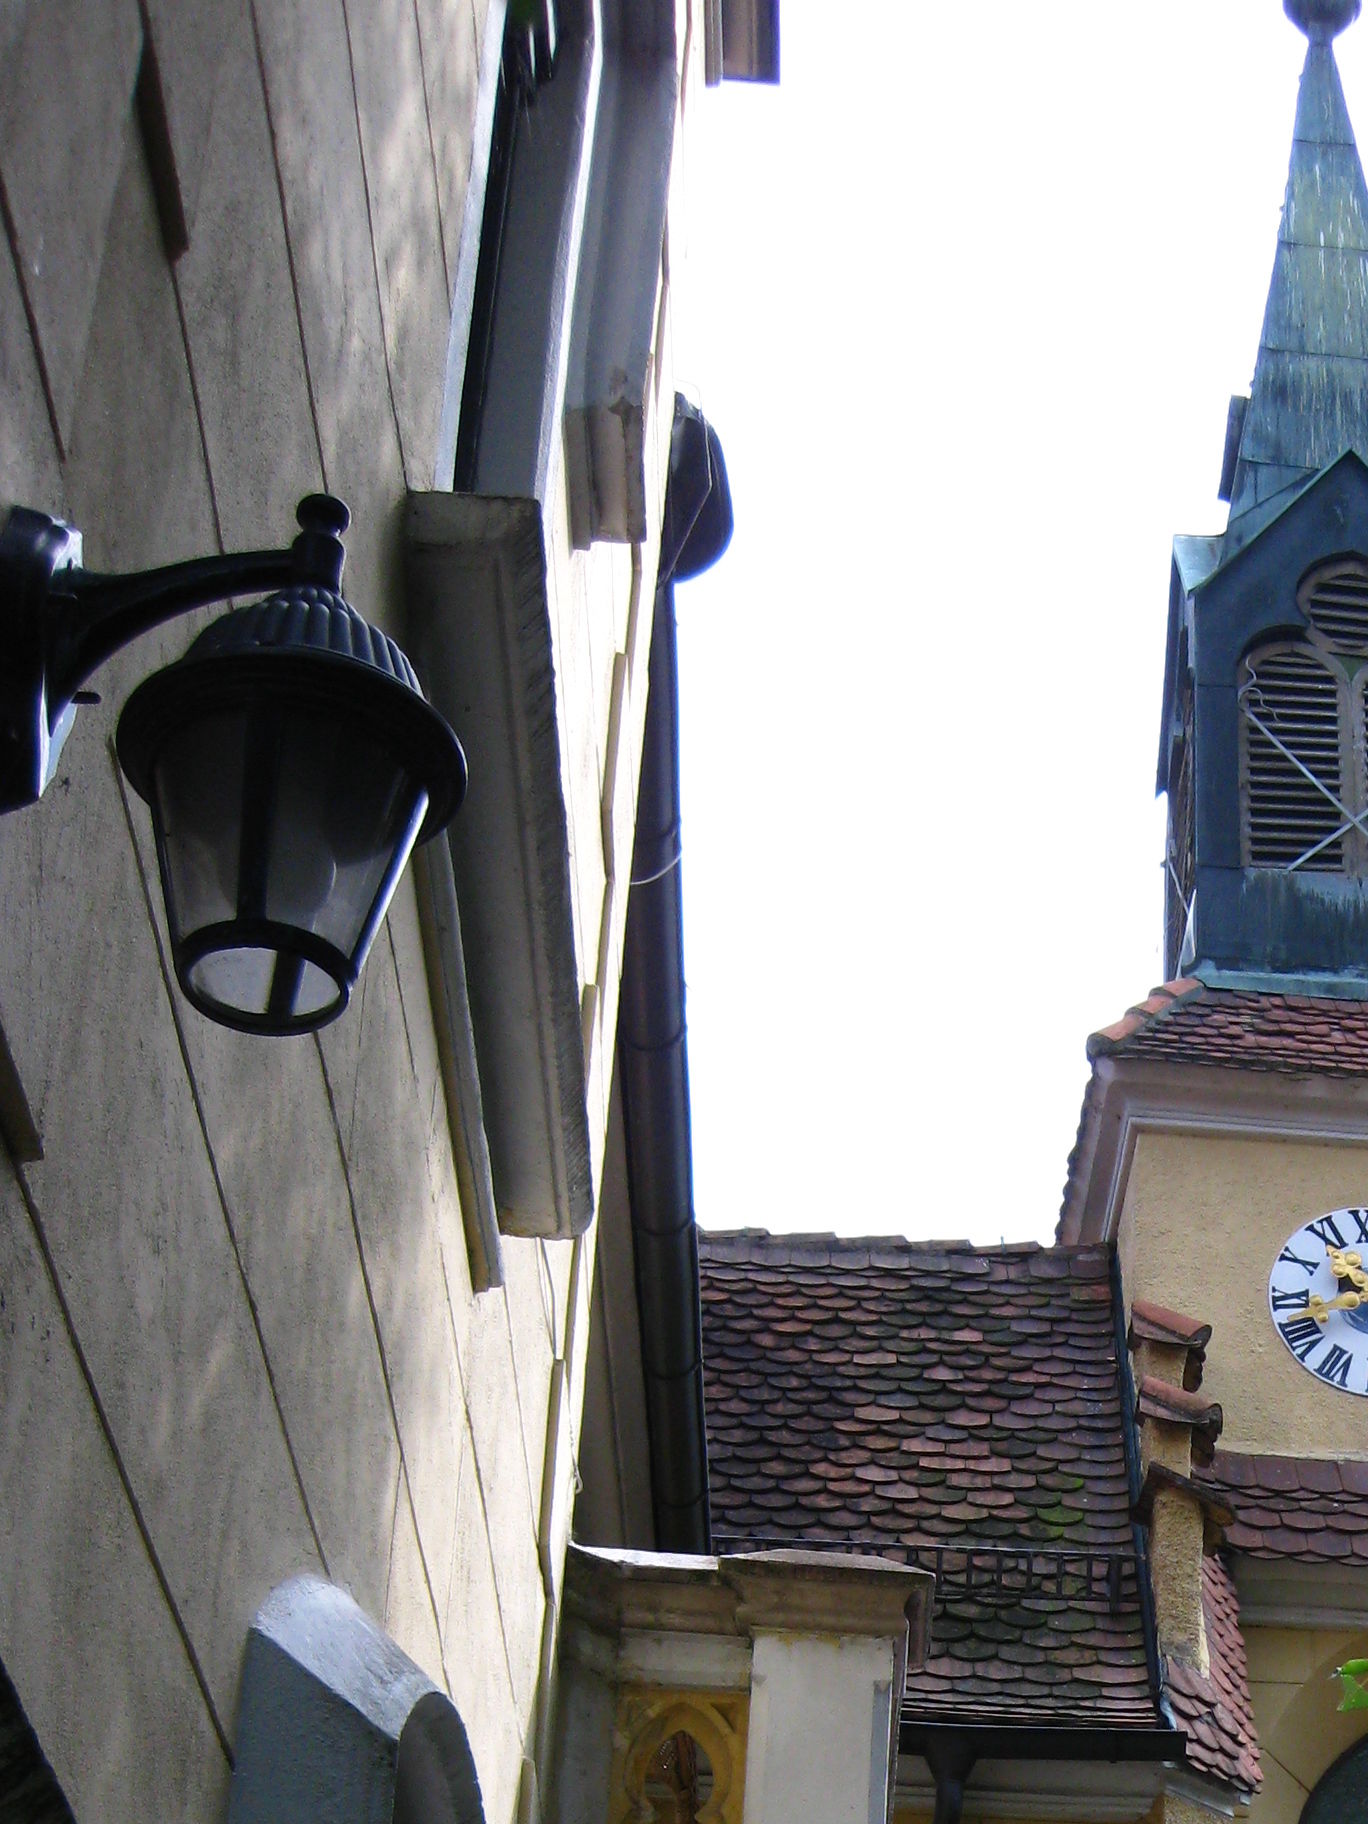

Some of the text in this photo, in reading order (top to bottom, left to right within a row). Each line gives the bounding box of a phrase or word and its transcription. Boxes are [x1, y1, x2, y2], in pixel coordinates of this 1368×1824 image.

[1305, 1215, 1348, 1257] XI
[1278, 1246, 1320, 1276] X
[1272, 1286, 1309, 1312] IX
[1278, 1318, 1325, 1363] VIII
[1313, 1344, 1353, 1388] VII
